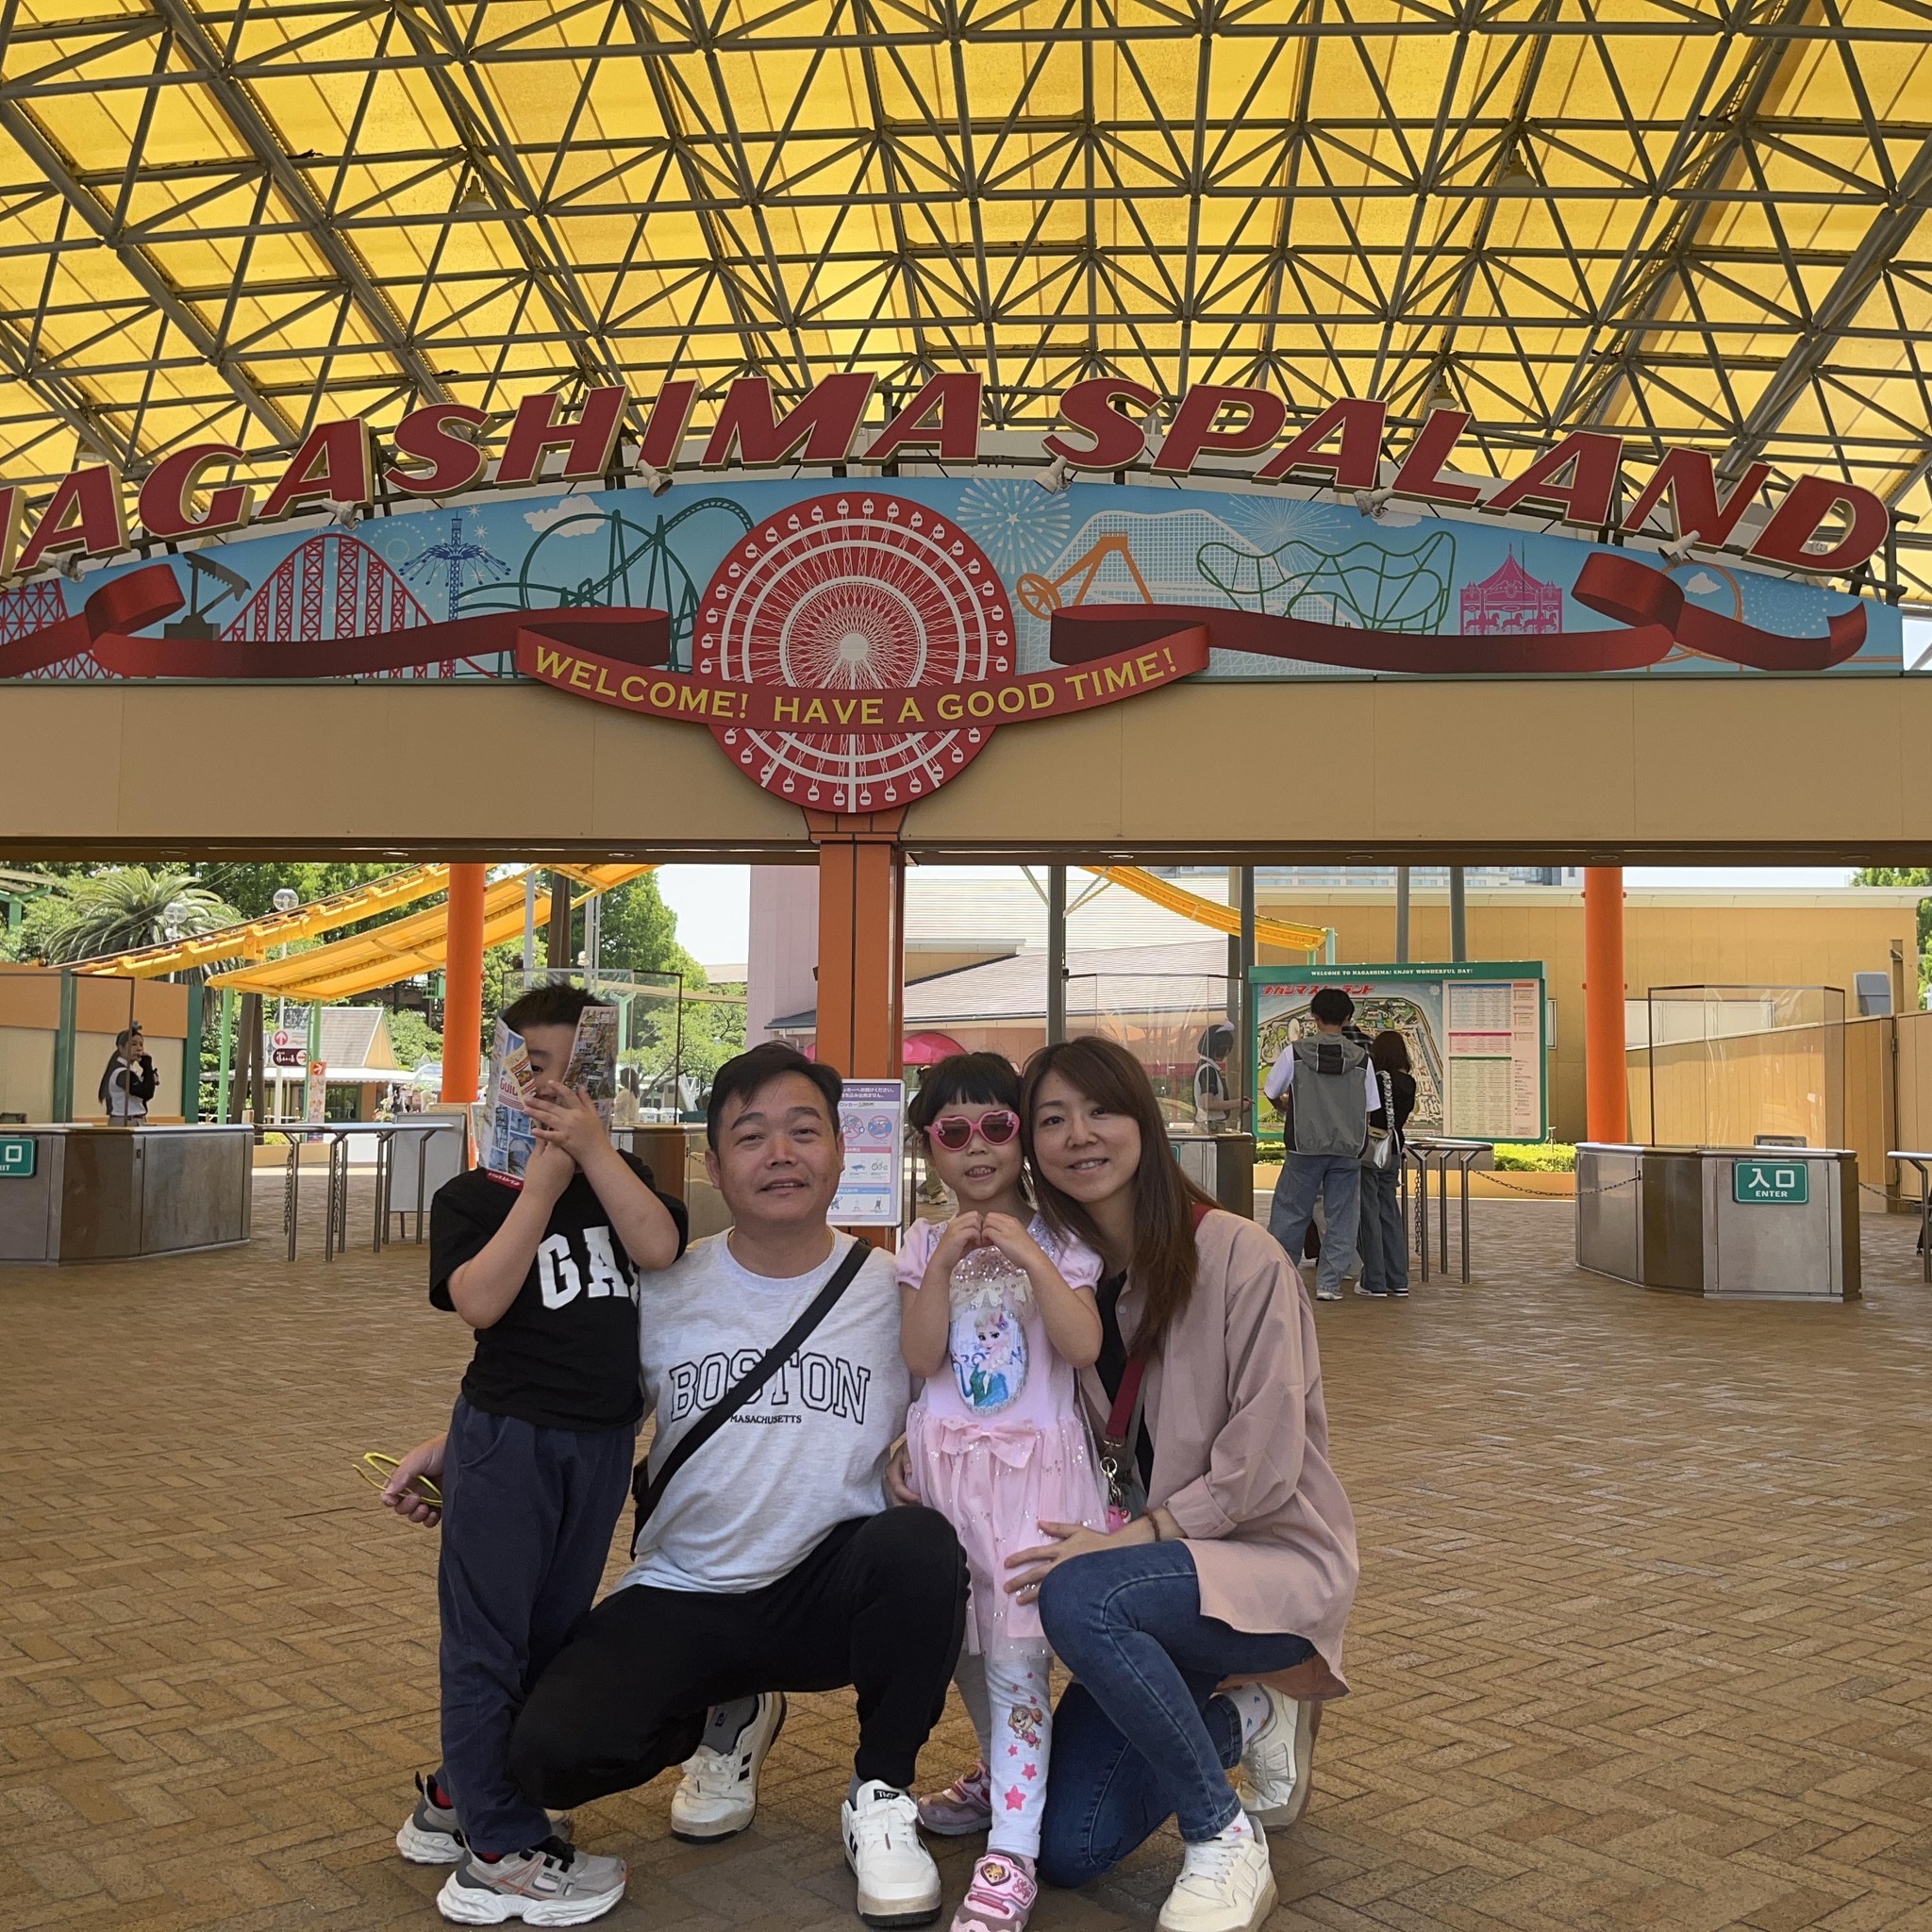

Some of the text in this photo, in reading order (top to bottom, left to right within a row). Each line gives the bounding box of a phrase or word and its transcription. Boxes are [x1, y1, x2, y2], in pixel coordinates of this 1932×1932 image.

[0, 372, 1890, 578] AGASHIMA SPALAND
[536, 645, 1176, 724] WELCOME! HAVE A GOOD TIME!
[1748, 1168, 1795, 1189] 入口
[538, 1225, 639, 1309] GA
